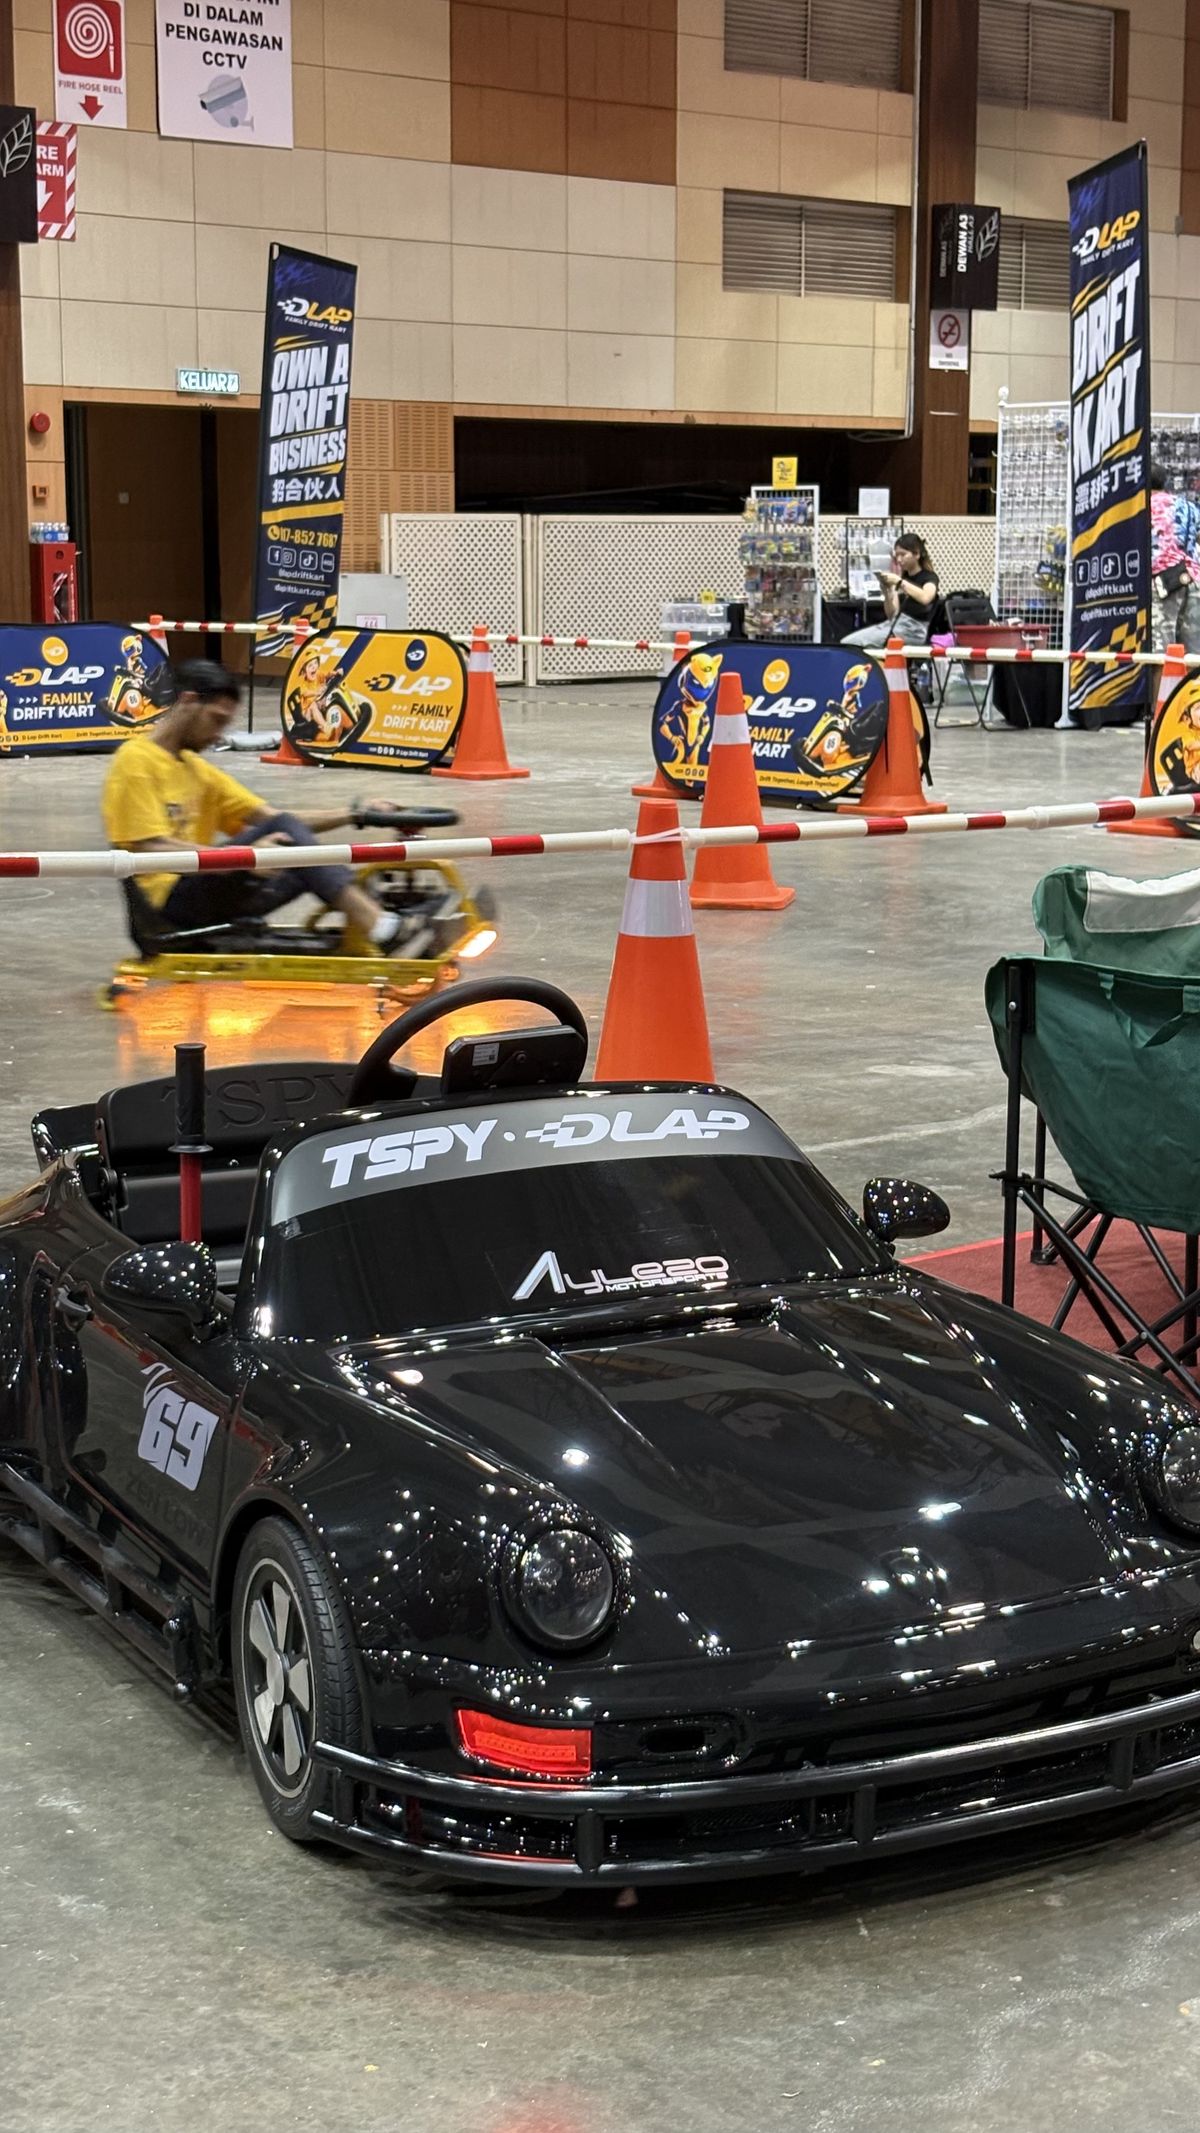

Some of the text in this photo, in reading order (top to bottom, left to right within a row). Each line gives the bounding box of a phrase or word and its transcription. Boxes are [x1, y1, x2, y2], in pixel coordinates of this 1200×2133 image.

[184, 2, 263, 26] DI DALAM
[165, 23, 283, 51] PENGAWASAN
[202, 50, 247, 69] CCTV
[58, 80, 123, 95] FIRE HOSE REEL
[1071, 210, 1141, 258] DLAP
[957, 231, 968, 273] DEWAN
[277, 297, 353, 326] DLAP
[1071, 259, 1141, 393] DRIFT
[271, 343, 350, 393] OWN A
[180, 371, 227, 392] KELUAR
[269, 384, 349, 438] DRIFT
[1073, 348, 1142, 482] KART
[268, 429, 347, 476] BUSINESS
[272, 476, 341, 504] 招合伙人
[5, 665, 105, 687] DLAP
[364, 674, 452, 696] DLAP
[42, 691, 94, 706] FAMILY
[410, 703, 454, 718] FAMILY
[13, 704, 97, 721] DRIFT KART
[383, 715, 452, 733] DRIFT KART
[749, 726, 795, 742] AMILY
[752, 742, 792, 758] KART
[322, 1109, 750, 1188] TSPY DLAP
[606, 1272, 728, 1293] MOTORSPORTS
[138, 1387, 220, 1492] 69
